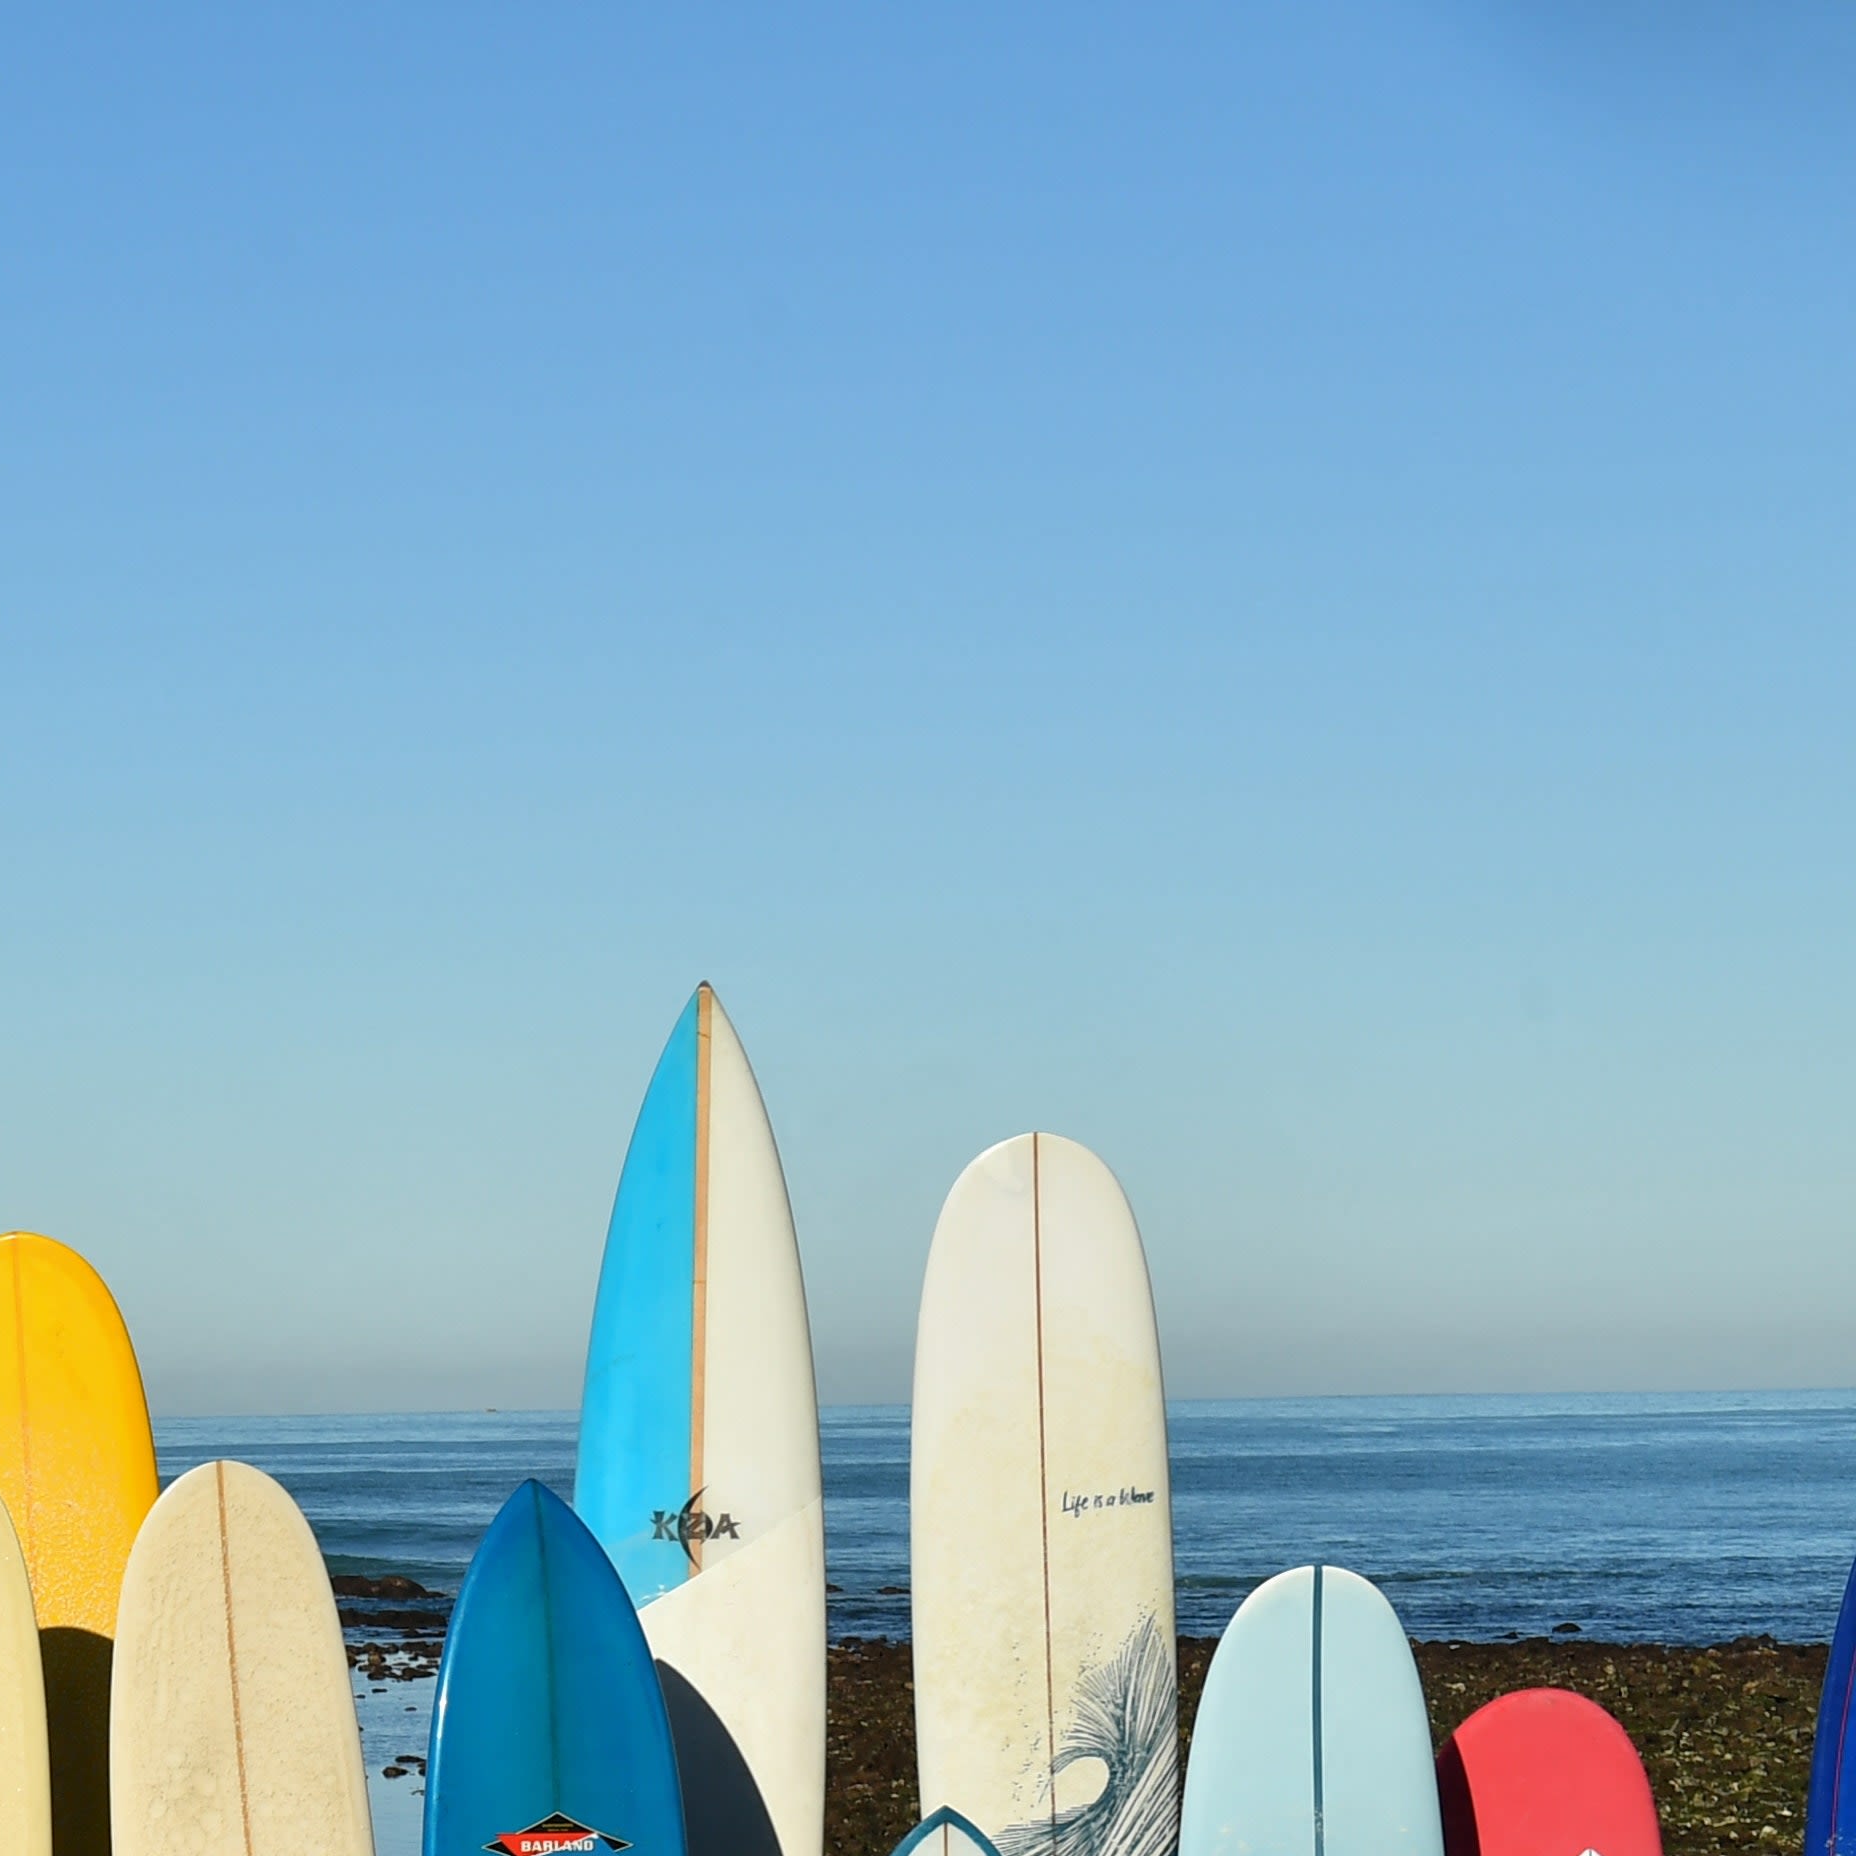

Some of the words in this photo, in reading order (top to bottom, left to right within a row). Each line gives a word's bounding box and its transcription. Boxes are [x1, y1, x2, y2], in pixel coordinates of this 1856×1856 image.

[1062, 1491, 1089, 1518] Life
[1093, 1494, 1104, 1508] is
[1106, 1495, 1117, 1506] a
[520, 1839, 595, 1853] BARLAND
